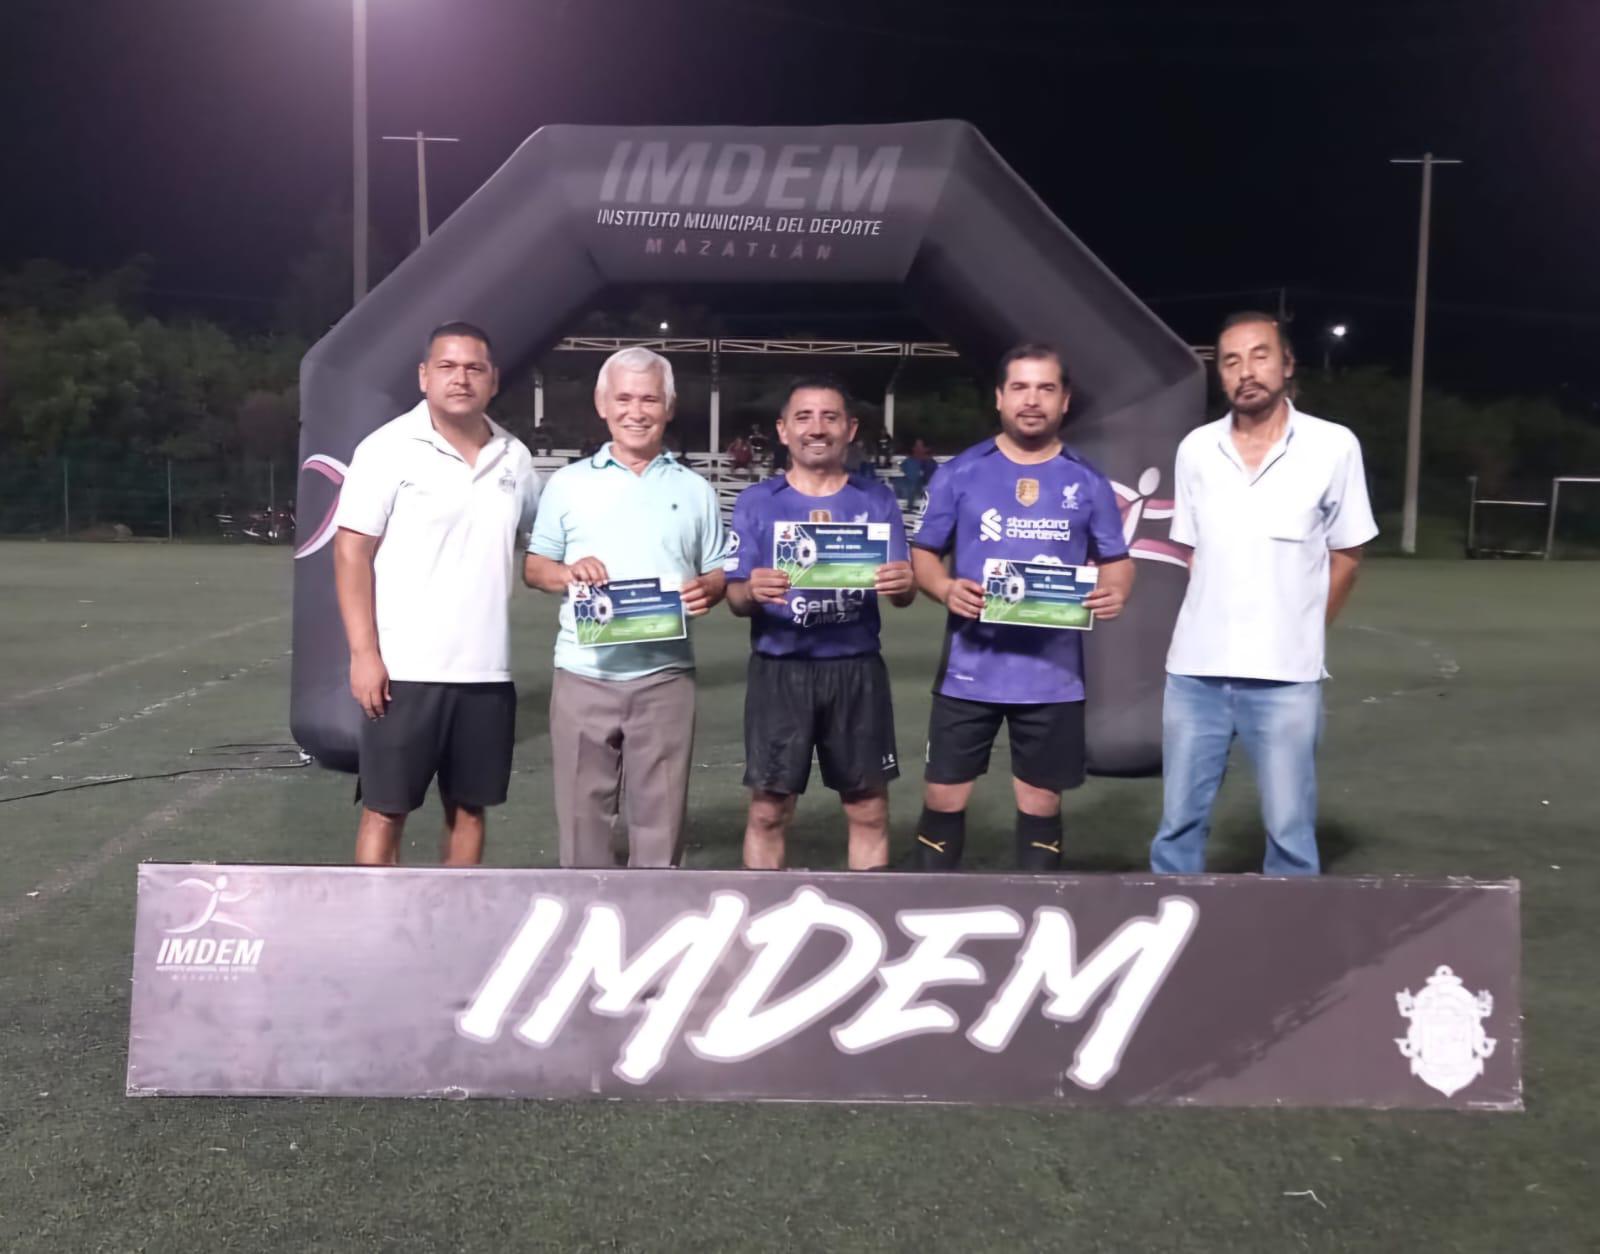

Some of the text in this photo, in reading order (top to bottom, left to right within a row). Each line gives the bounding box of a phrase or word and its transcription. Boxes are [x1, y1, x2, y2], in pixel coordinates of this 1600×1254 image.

[600, 141, 903, 213] IMDEM
[597, 208, 883, 236] INSTITUTO MUNICIPAL DEL DEPORTE
[156, 938, 265, 965] IMDEM
[455, 885, 1200, 1089] IMDEM
